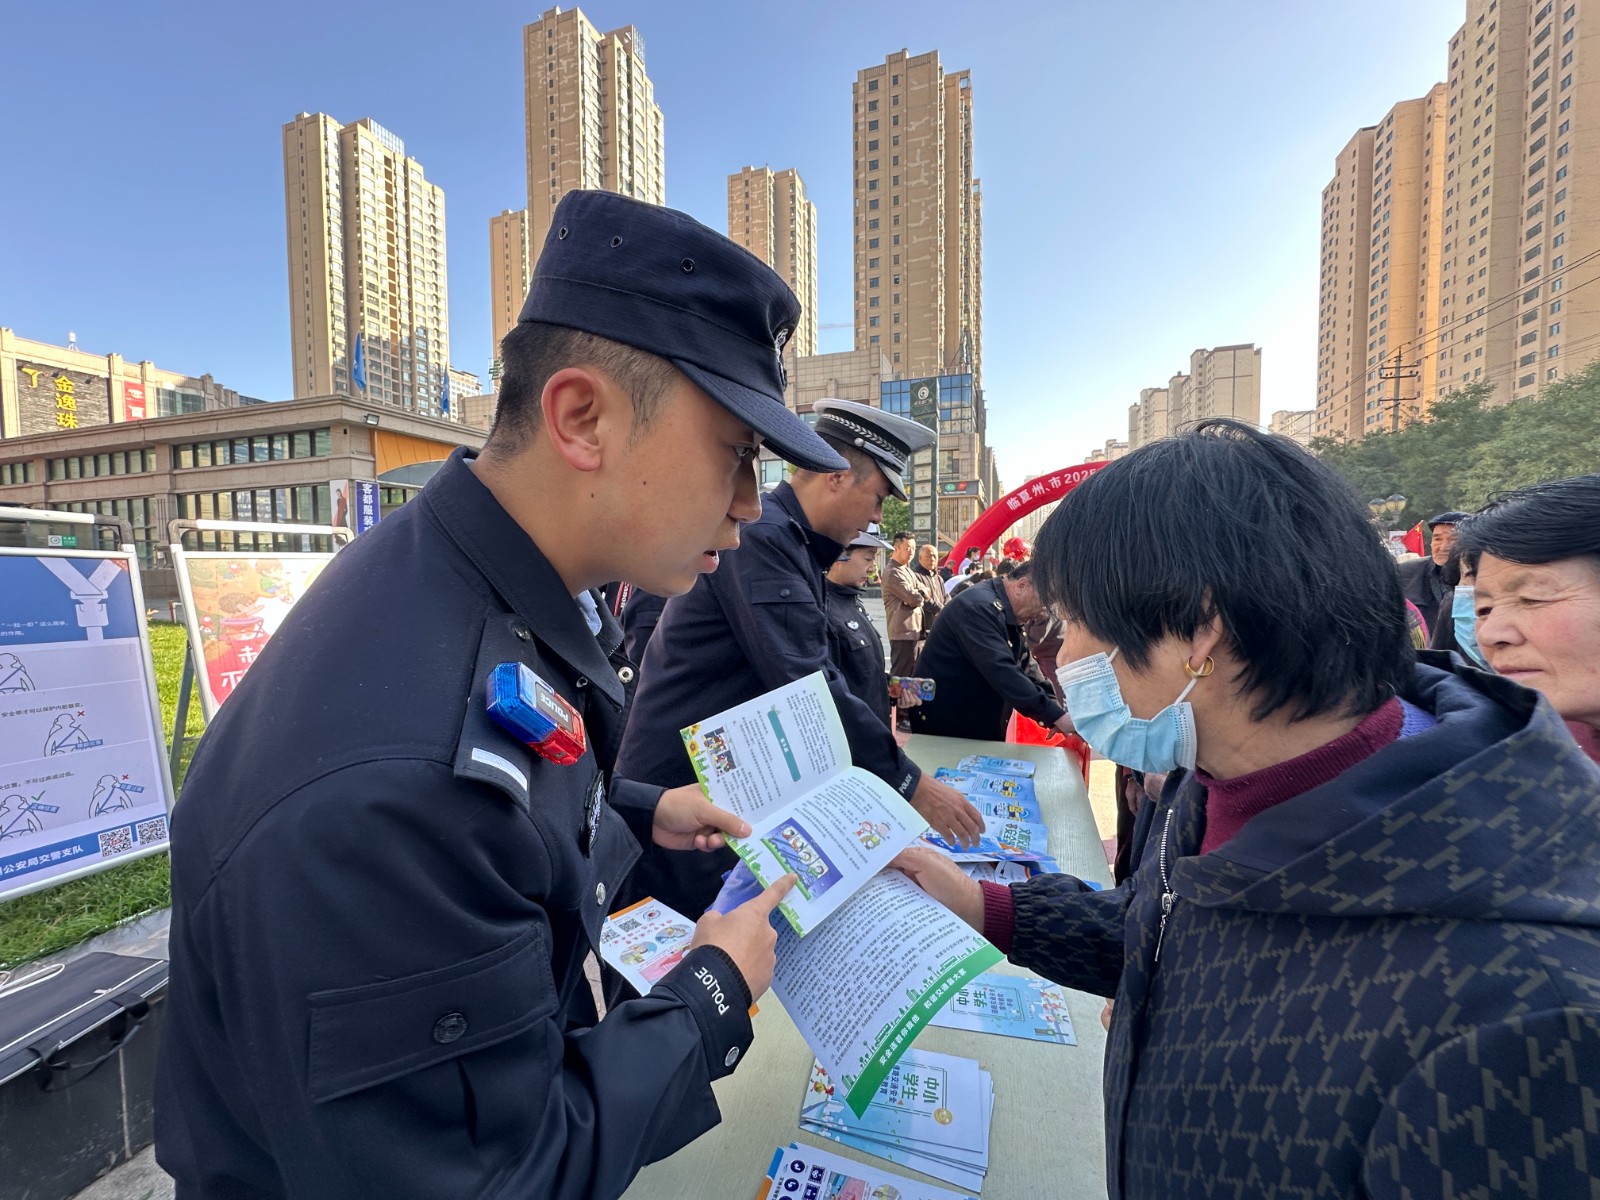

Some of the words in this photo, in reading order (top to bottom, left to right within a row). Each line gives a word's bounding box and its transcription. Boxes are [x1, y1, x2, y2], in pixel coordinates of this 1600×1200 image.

[54, 375, 78, 429] 金逸珠
[541, 692, 569, 722] POLICE
[898, 773, 913, 794] POLICE
[694, 966, 730, 1016] POLICE
[973, 990, 988, 1008] 学生
[879, 1014, 920, 1066] 安全连着你我他
[924, 968, 967, 1009] 和谐交通靠大家
[901, 1072, 920, 1101] 学生
[922, 1075, 940, 1103] 中小
